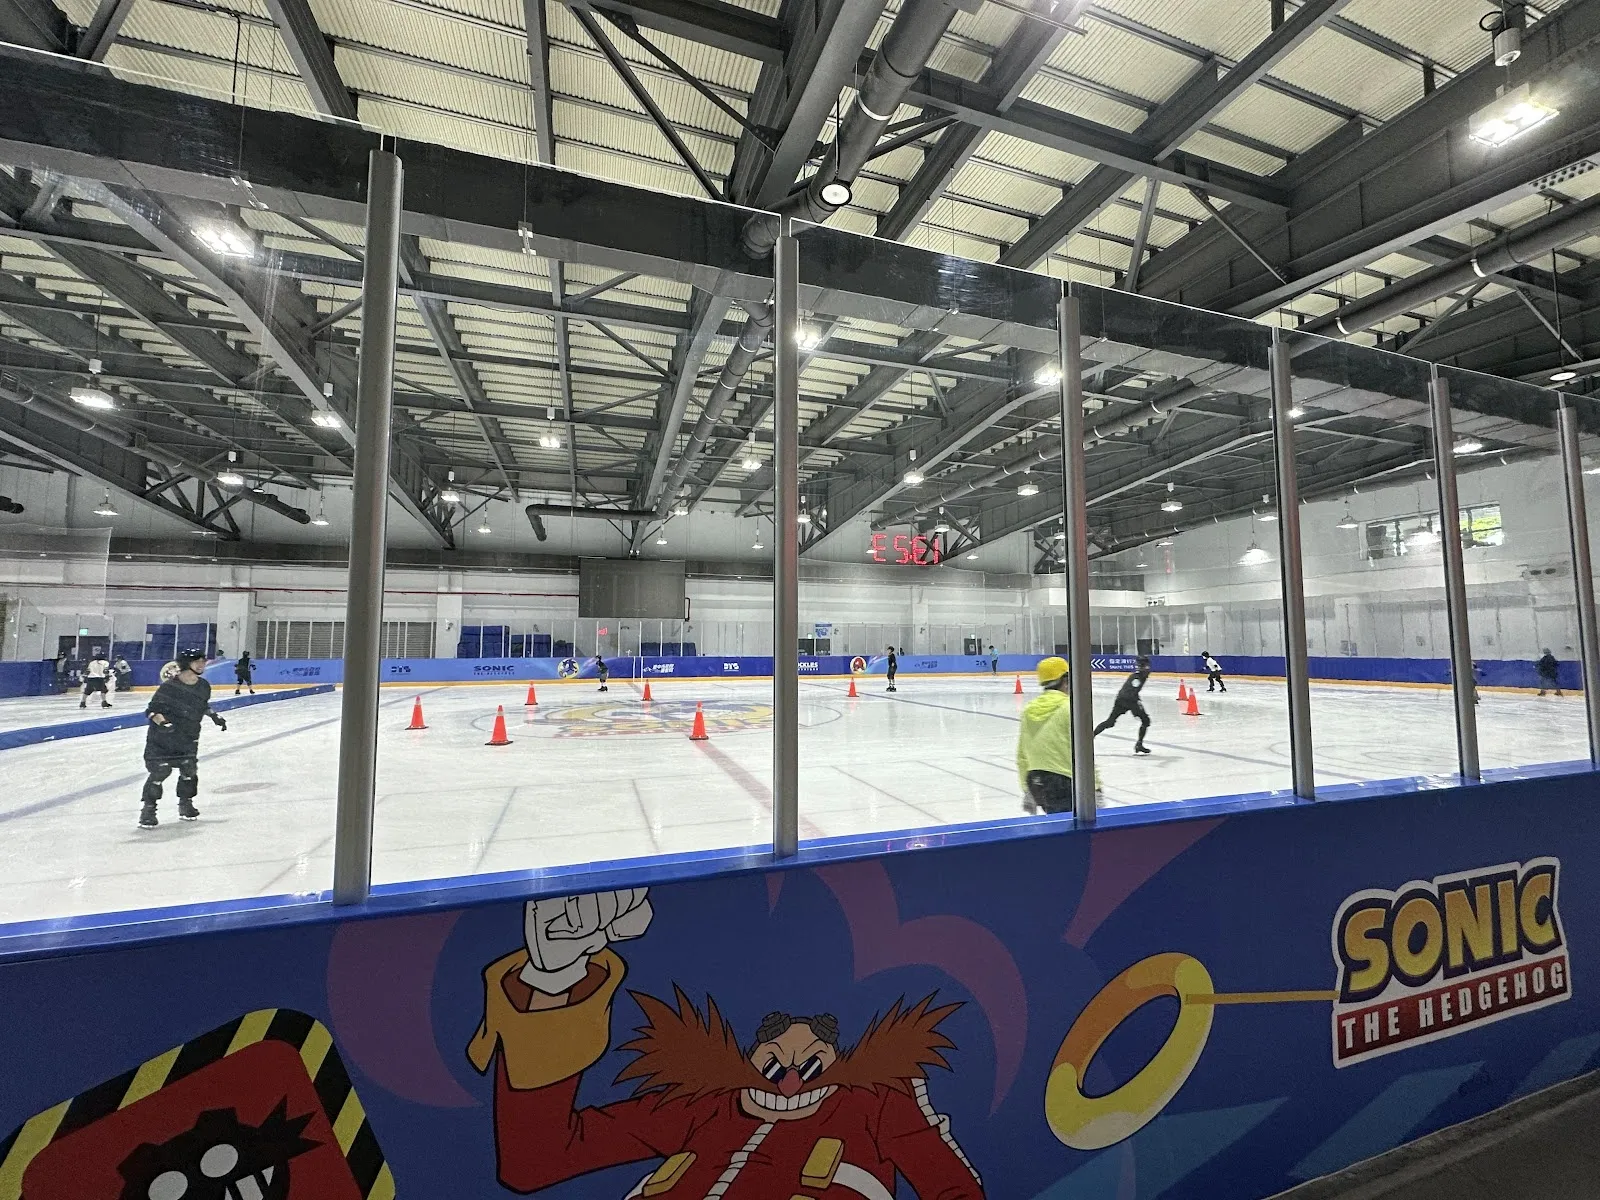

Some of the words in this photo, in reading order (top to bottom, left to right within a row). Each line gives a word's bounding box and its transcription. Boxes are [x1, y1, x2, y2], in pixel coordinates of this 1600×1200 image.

[1341, 867, 1558, 998] SONIC
[1341, 1006, 1401, 1050] THE
[1418, 961, 1565, 1029] HEDGEHOG
